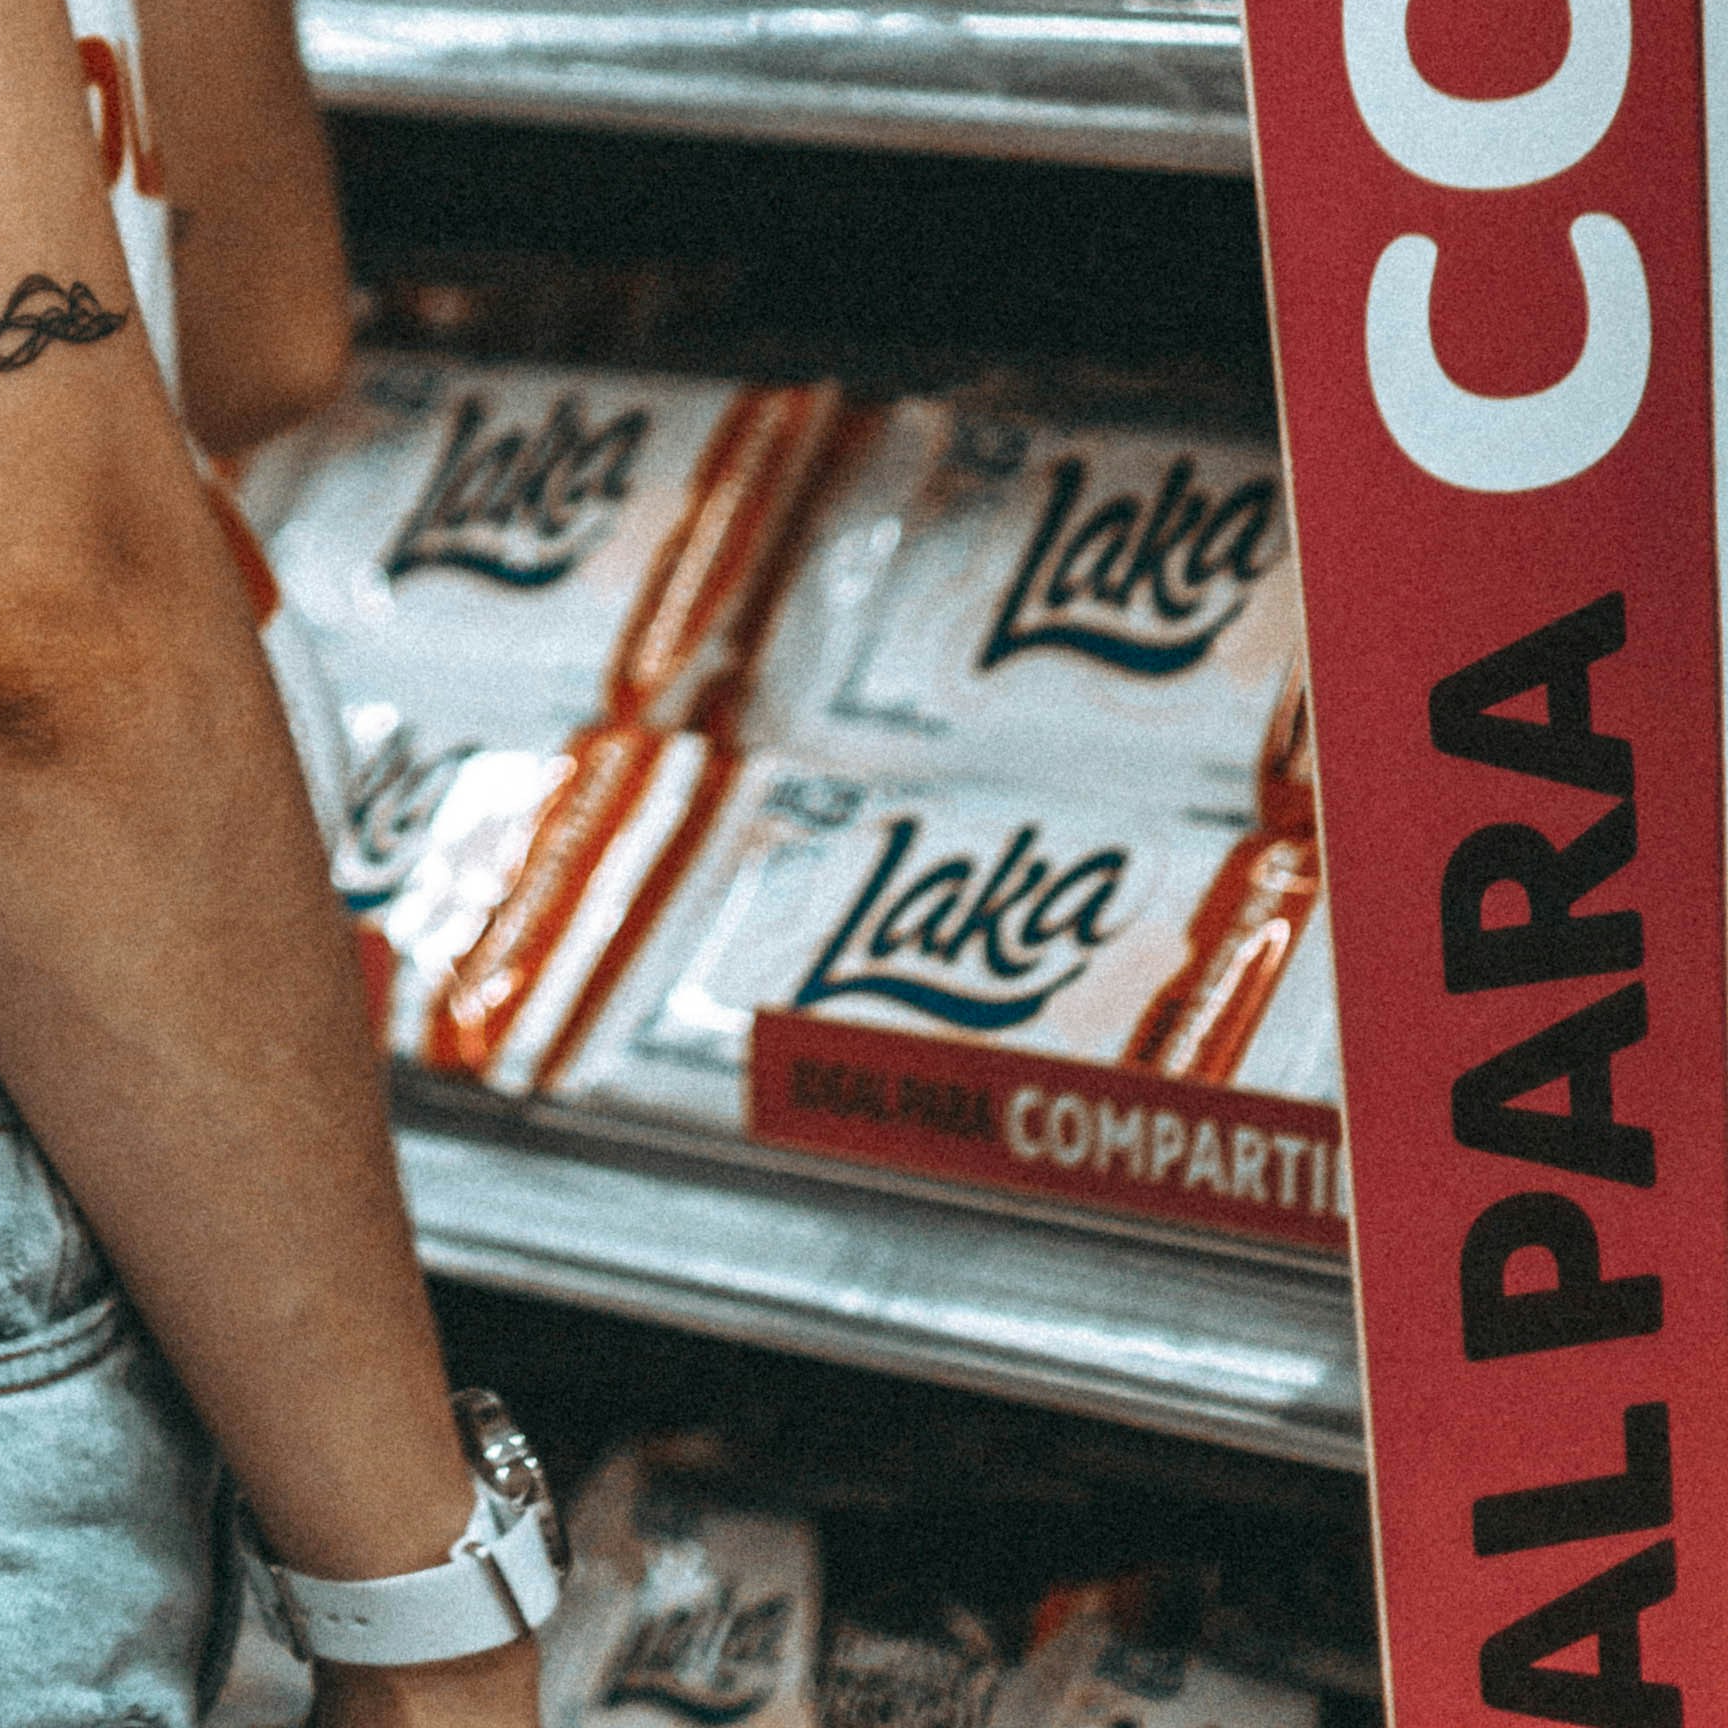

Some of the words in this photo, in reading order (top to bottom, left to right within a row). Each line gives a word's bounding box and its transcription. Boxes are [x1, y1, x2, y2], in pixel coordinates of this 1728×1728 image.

[382, 392, 652, 589] Laka
[976, 452, 1278, 679] Laka
[792, 814, 1132, 1029] Laka
[1427, 587, 1665, 1365] PARA
